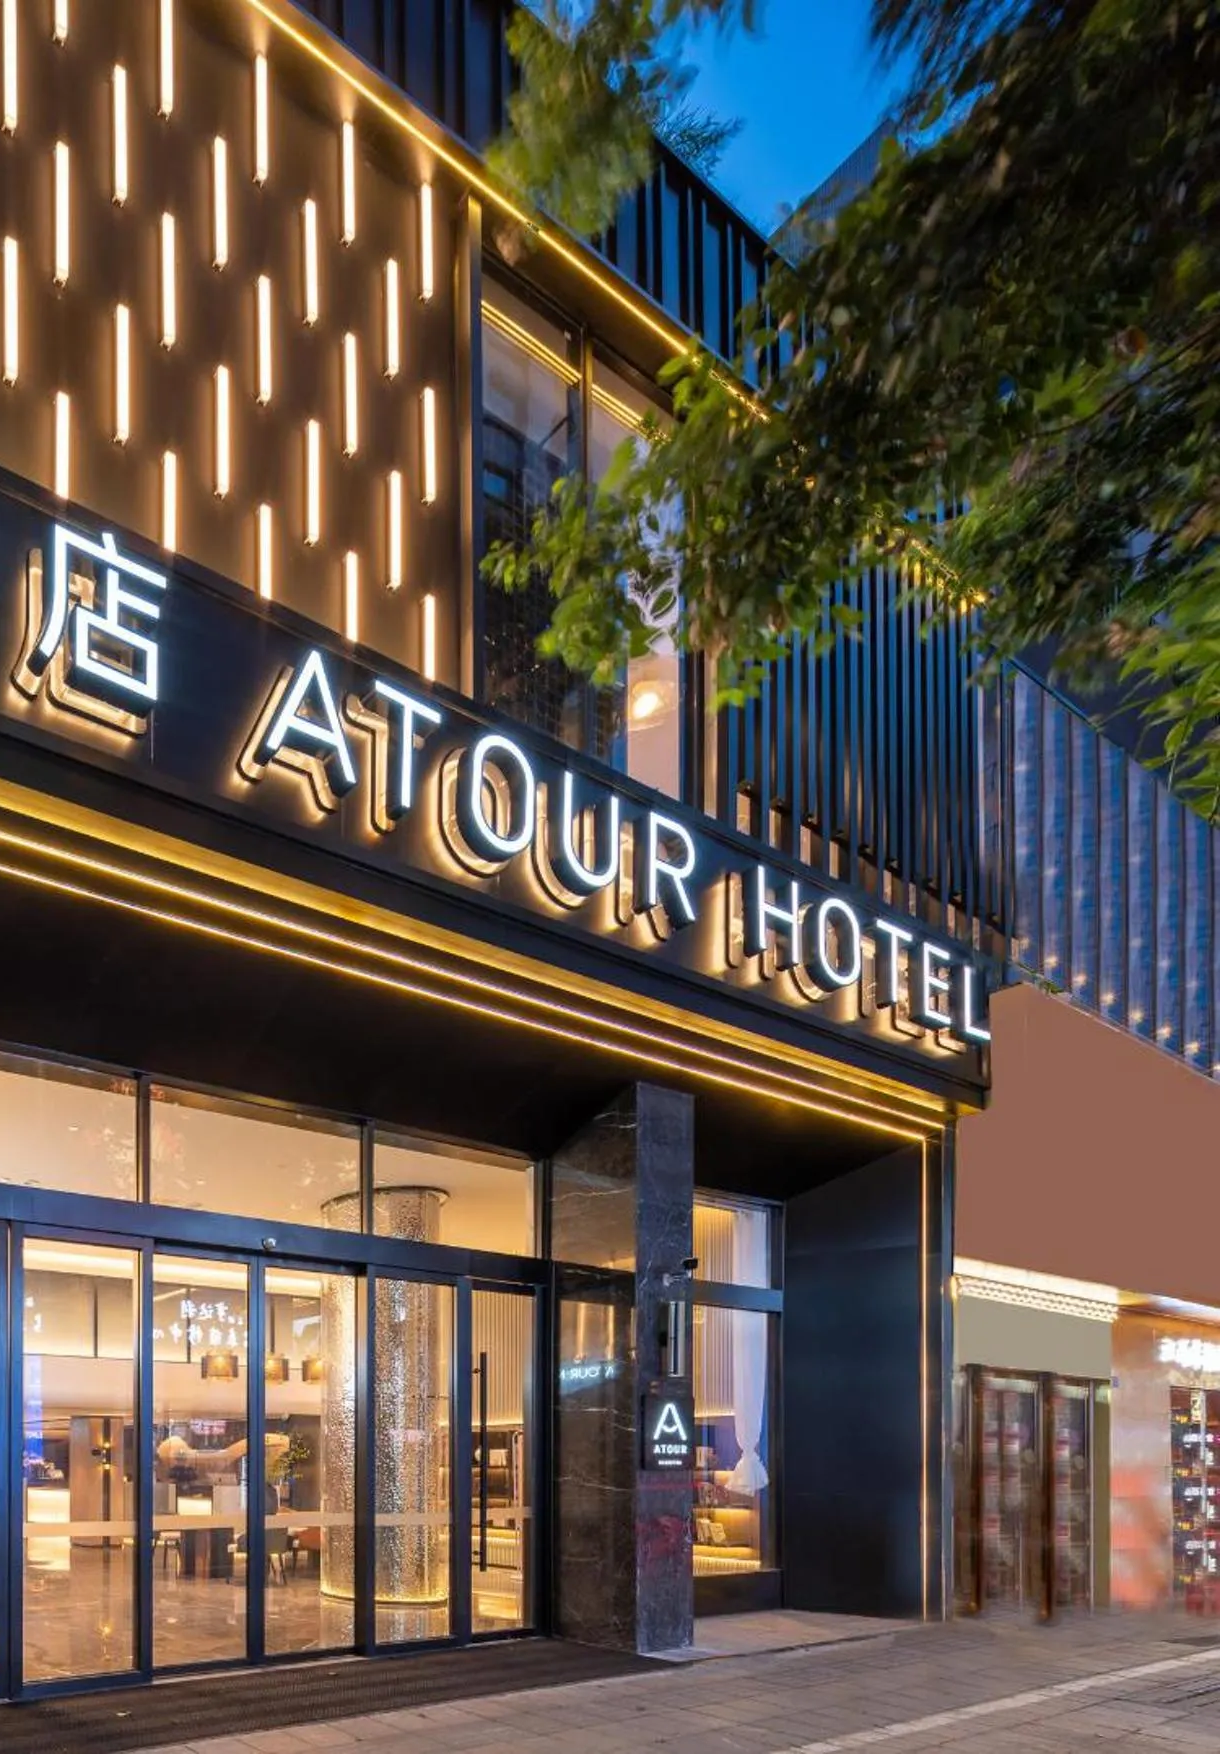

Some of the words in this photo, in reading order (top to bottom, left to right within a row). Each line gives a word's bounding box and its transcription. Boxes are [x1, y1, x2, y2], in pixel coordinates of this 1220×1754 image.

[264, 649, 698, 923] ATOUR
[757, 863, 992, 1041] HOTEL
[653, 1443, 688, 1456] ATOUR
